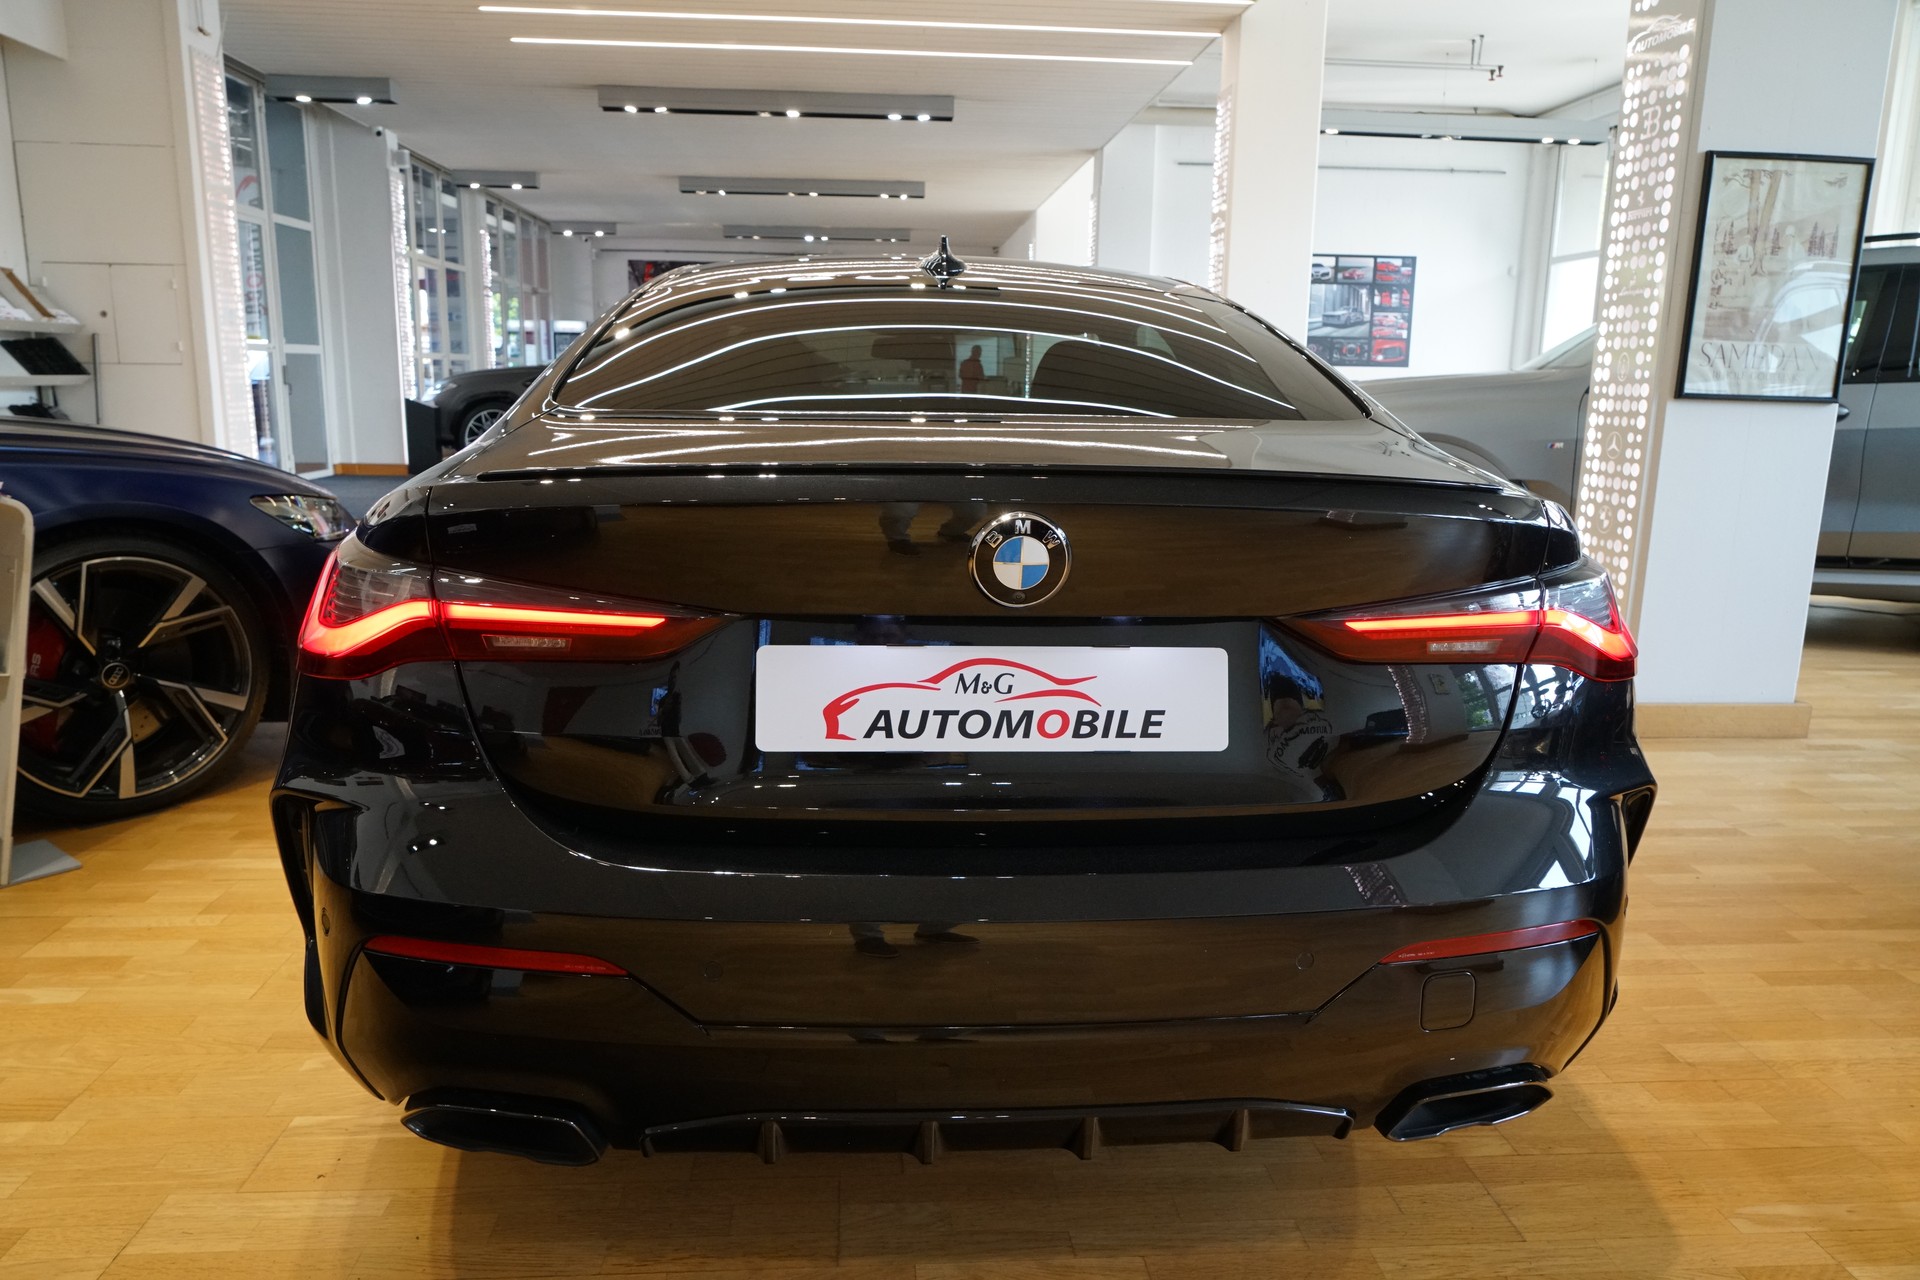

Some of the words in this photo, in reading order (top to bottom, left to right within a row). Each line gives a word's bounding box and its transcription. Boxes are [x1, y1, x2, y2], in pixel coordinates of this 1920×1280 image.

[985, 519, 1060, 549] BMW
[955, 672, 1015, 695] M&G
[863, 709, 1166, 739] AUTOMOBILE
